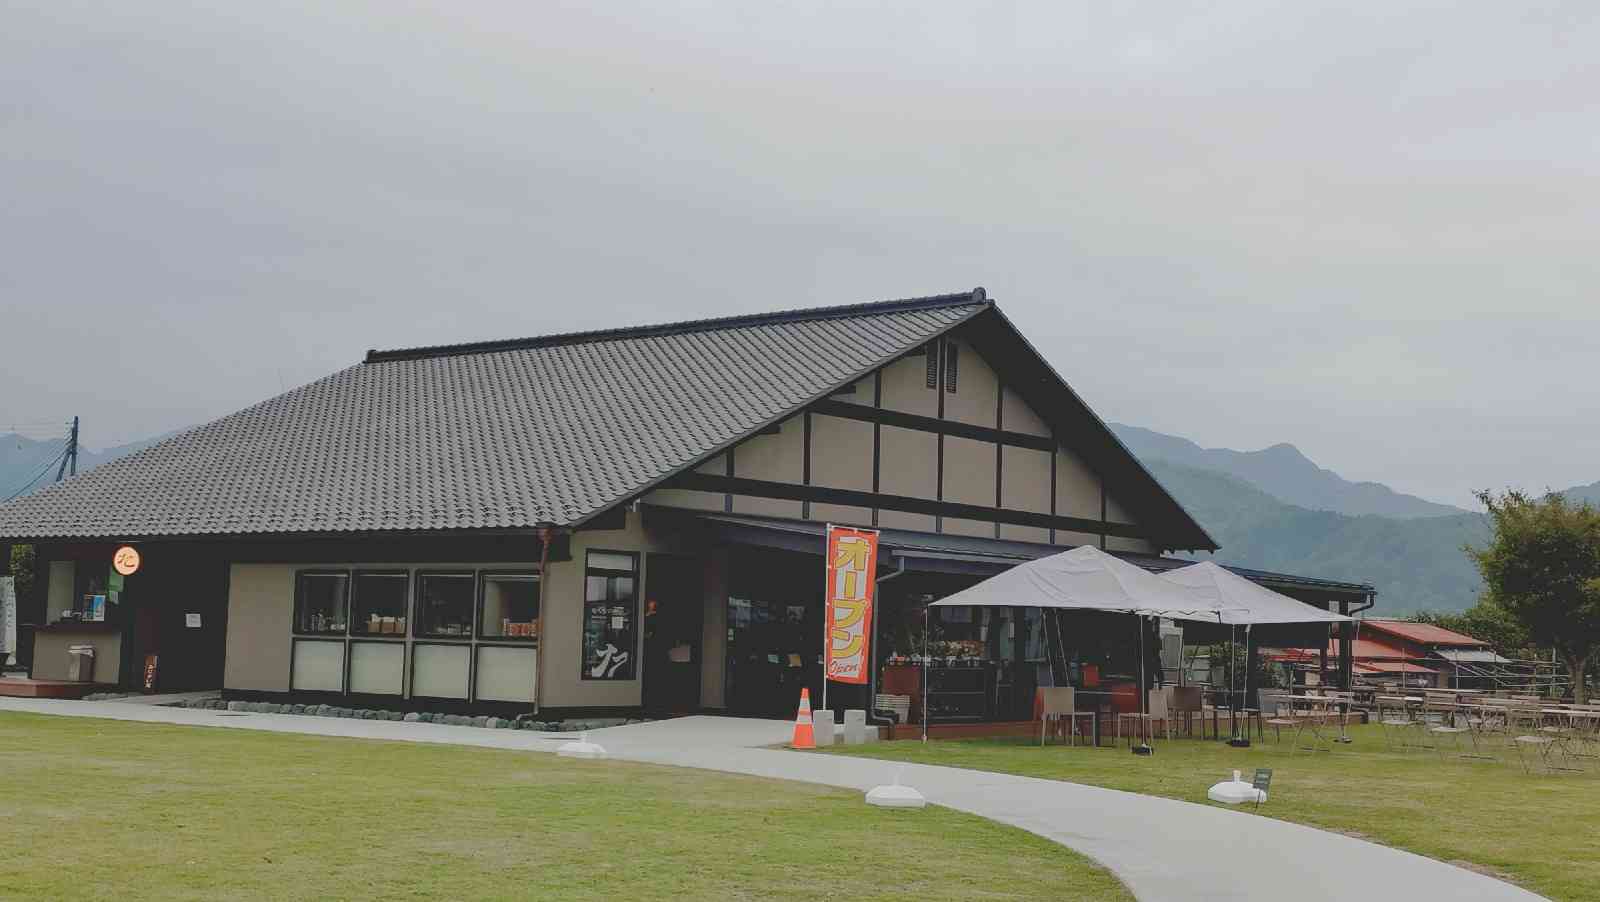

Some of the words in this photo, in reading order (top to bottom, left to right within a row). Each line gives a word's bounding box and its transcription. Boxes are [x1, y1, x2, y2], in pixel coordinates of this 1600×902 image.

[831, 535, 870, 660] オープン
[829, 661, 859, 678] Open
